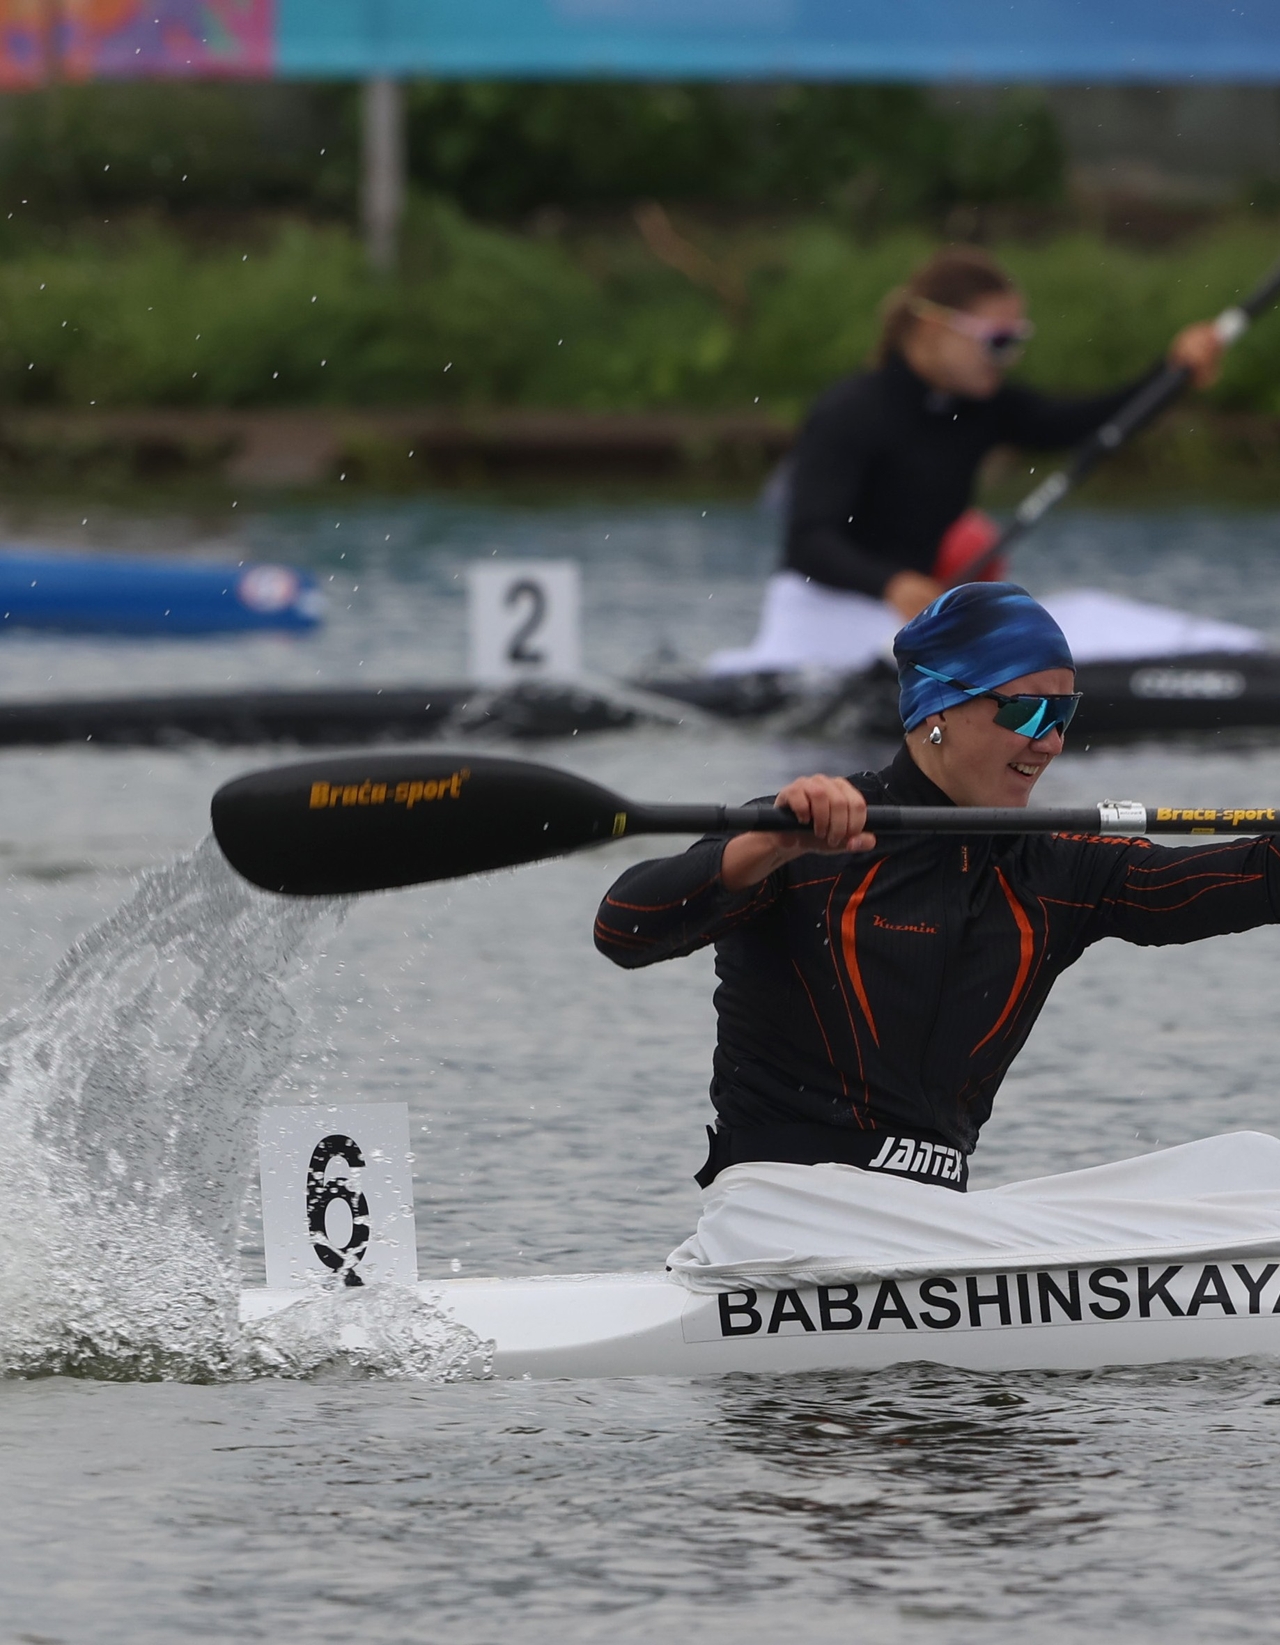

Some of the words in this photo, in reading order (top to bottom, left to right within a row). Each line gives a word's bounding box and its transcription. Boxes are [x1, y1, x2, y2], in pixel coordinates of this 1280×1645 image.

[503, 577, 549, 667] 2
[873, 915, 937, 934] Kuzmin
[306, 1134, 370, 1270] 6
